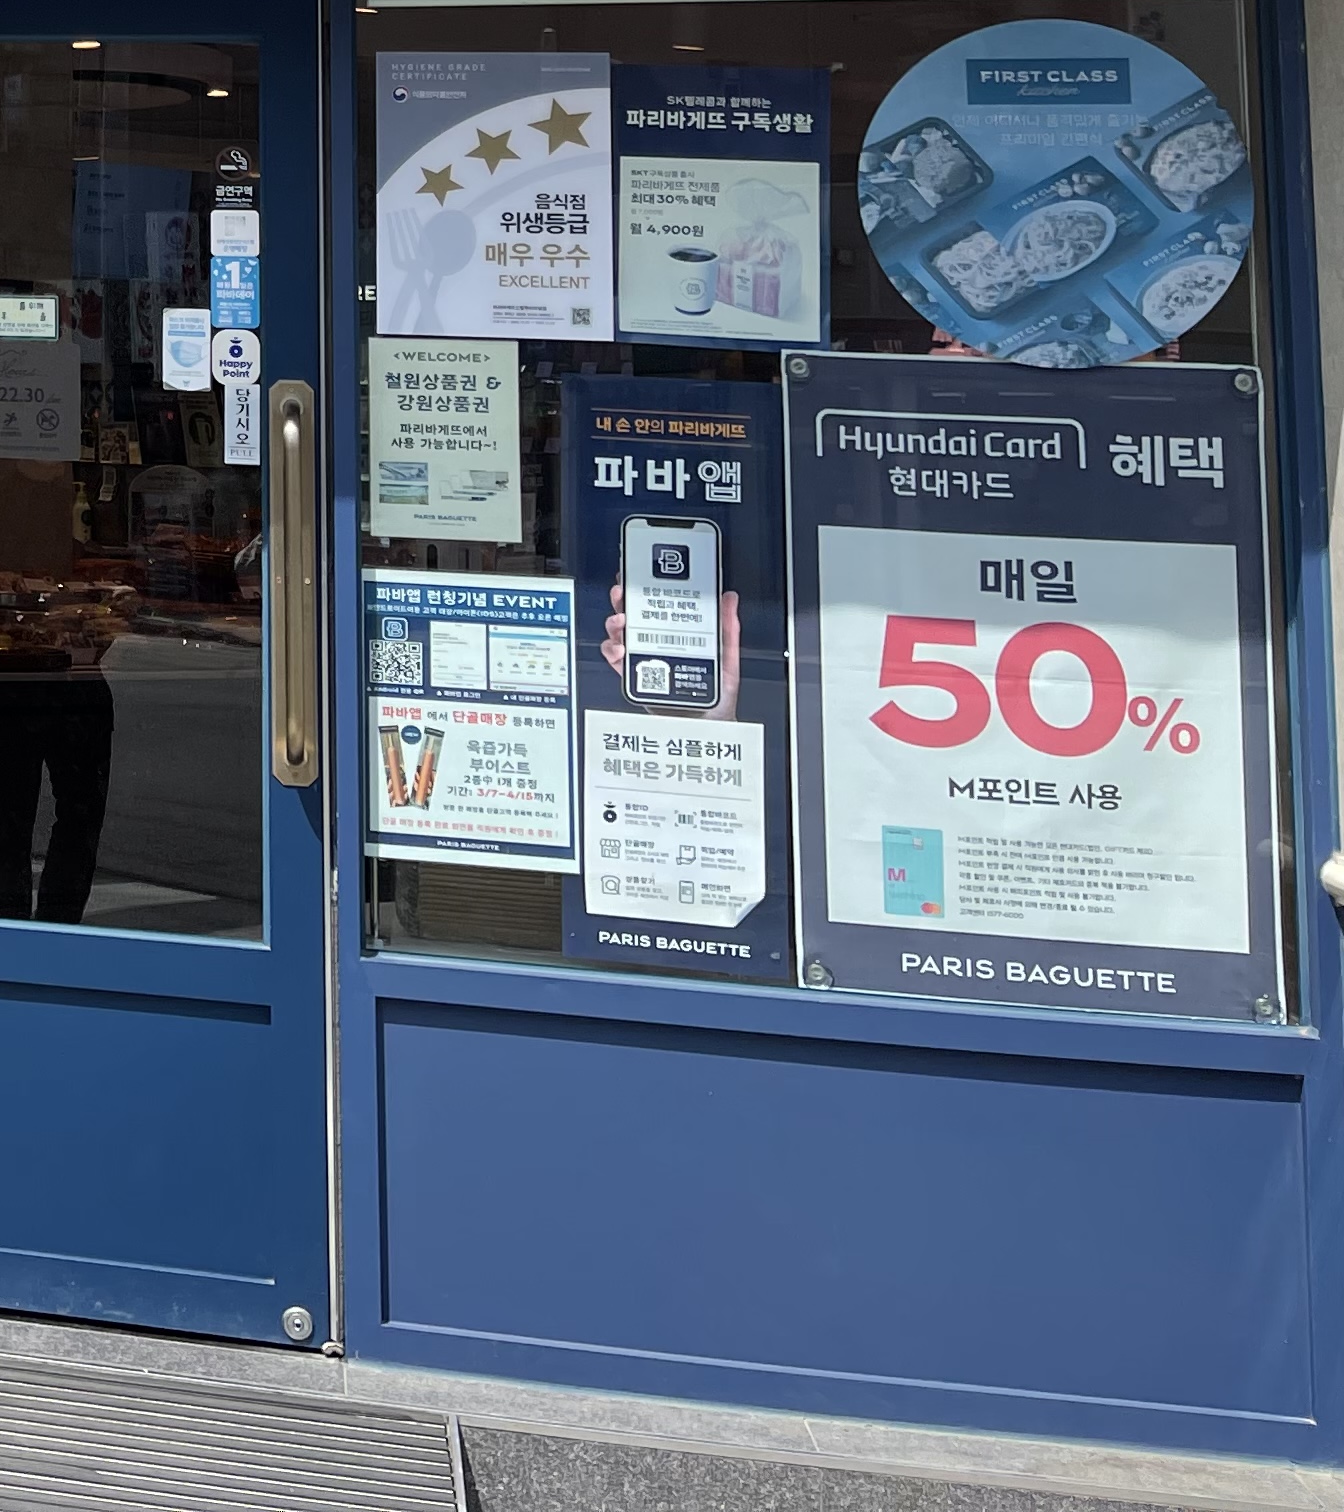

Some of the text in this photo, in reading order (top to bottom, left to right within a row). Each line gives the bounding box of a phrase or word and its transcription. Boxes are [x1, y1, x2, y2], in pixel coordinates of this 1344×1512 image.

[391, 63, 487, 72] HYGIENE GRADE
[391, 73, 468, 81] CERTIFICATE
[979, 70, 1119, 83] FIRST CLASS
[730, 96, 772, 109] 함께하는
[626, 109, 814, 134] 파리바게뜨 구독생활
[215, 185, 254, 197] 금연구역
[630, 193, 655, 205] 최대
[656, 194, 689, 205] 30%
[534, 192, 586, 210] 음식점
[499, 211, 590, 235] 위생등급
[629, 222, 704, 238] 월 4,900원
[484, 242, 591, 269] 매우 우수
[498, 274, 591, 289] EXCELLENT
[219, 359, 253, 370] Happy
[222, 369, 250, 378] Point
[384, 371, 502, 392] 철원상품권 &
[397, 394, 490, 414] 강원상품권
[235, 388, 251, 445] 당기시오
[399, 423, 488, 438] 파리바게뜨에서
[595, 416, 747, 439] 내 손 안의 파리바게뜨
[229, 448, 254, 457] PULL
[390, 437, 415, 450] 사용
[838, 424, 1063, 463] Hyundai Card
[1109, 434, 1225, 489] 혜택
[888, 466, 1015, 501] 현대카드
[413, 513, 477, 522] PARIS BAGUETTE
[979, 557, 1079, 604] 매일
[376, 587, 558, 610] 파바앱 런칭기념 EVENT
[869, 614, 1201, 757] 50%
[381, 705, 557, 730] 파바앱 에서 단골매장 등록하면
[466, 739, 529, 758] 육즙가득
[602, 732, 743, 762] 결제는 심플하게
[469, 757, 532, 776] 부어스트
[603, 757, 743, 788] 혜택은 가득하게
[515, 777, 538, 790] 증정
[948, 777, 1123, 812] M포인트 사용
[887, 867, 906, 883] M
[598, 930, 752, 959] PARIS BAGUETTE
[900, 951, 1177, 994] PARIS BAGUETTE
